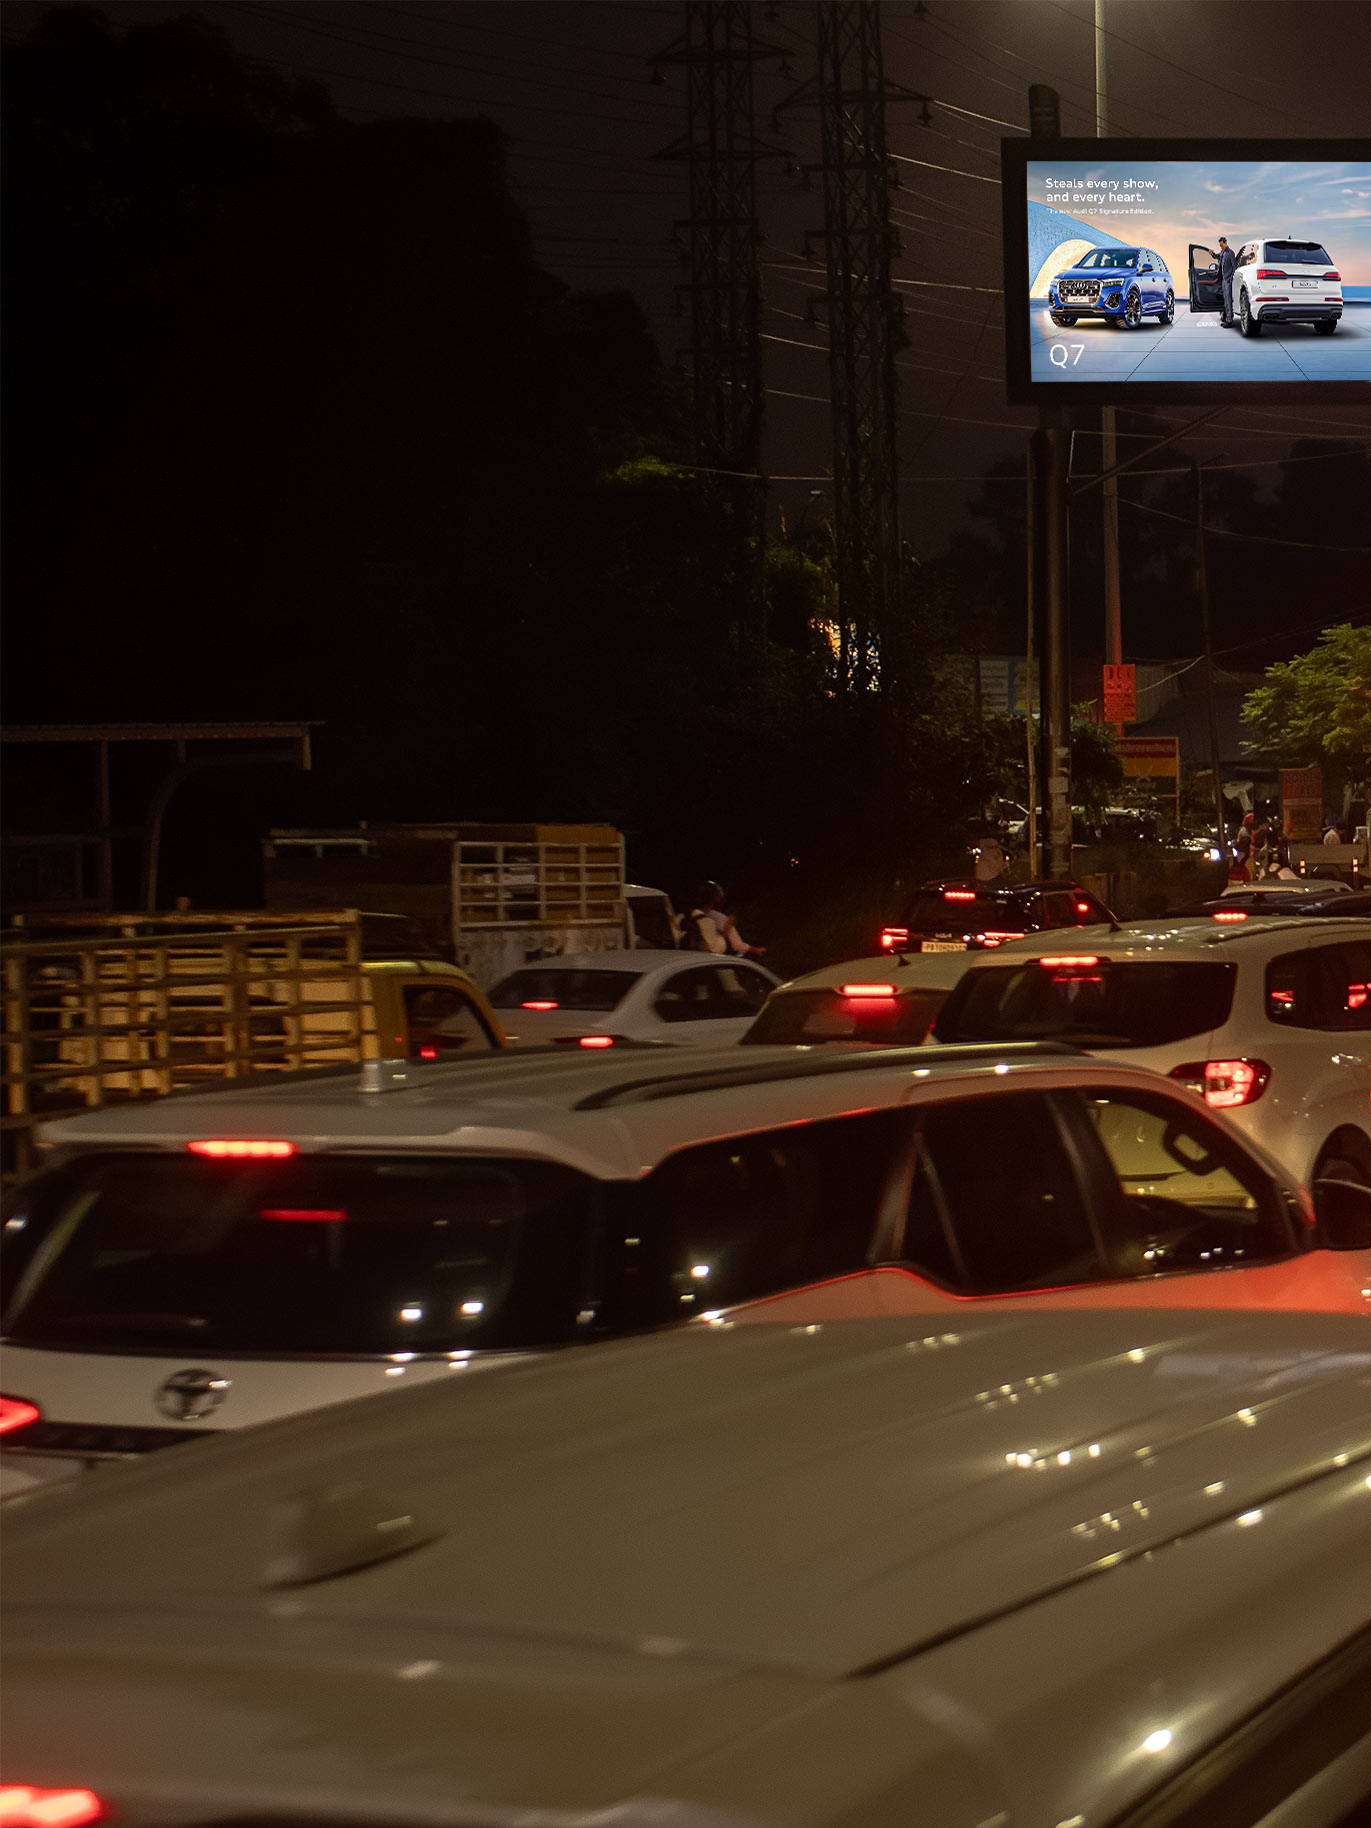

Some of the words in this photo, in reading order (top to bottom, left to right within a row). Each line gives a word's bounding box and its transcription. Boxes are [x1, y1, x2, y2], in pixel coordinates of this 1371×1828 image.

[1045, 177, 1084, 189] Steals
[1086, 179, 1120, 191] every
[1123, 177, 1160, 190] show,
[1046, 191, 1069, 202] and
[1072, 193, 1106, 204] every
[1109, 191, 1145, 202] heart.
[1088, 207, 1097, 215] Q7
[1099, 207, 1128, 216] Signature
[1130, 207, 1154, 215] Edition.
[1050, 344, 1085, 368] Q7
